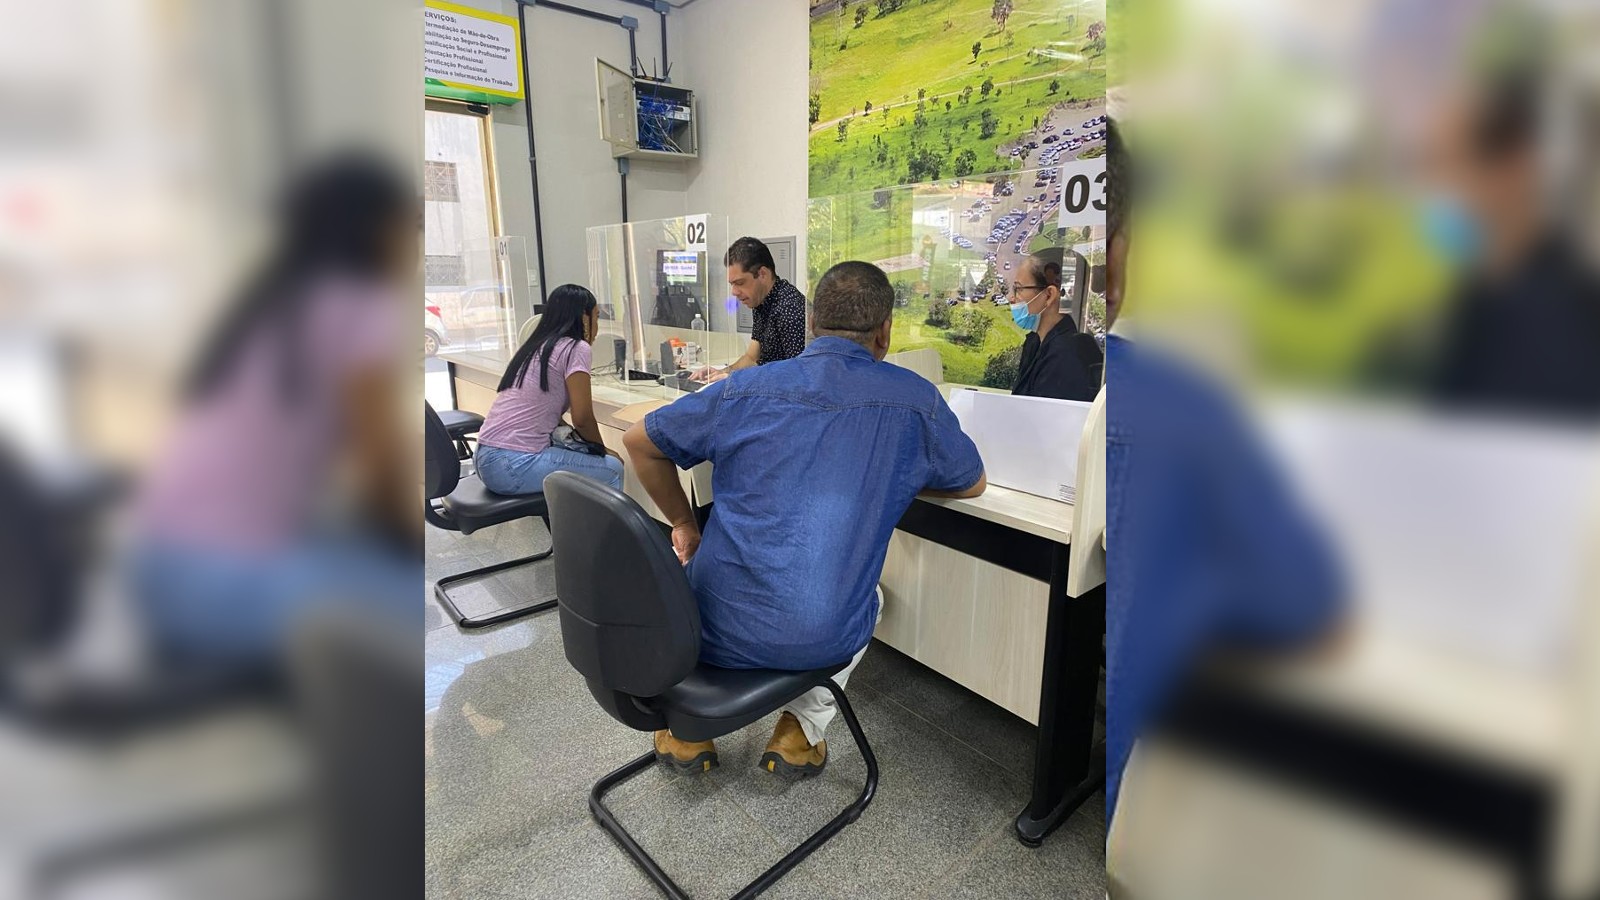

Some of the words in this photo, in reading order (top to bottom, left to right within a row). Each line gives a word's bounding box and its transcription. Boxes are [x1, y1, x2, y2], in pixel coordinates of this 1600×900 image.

[453, 54, 484, 64] Profissional
[456, 45, 472, 53] Social
[478, 50, 507, 60] Profissional
[457, 63, 488, 73] Profissional
[425, 66, 449, 76] Pesquisa
[454, 71, 484, 82] Informação
[491, 78, 513, 87] Trabalho
[1065, 171, 1106, 214] 03
[687, 222, 705, 244] 02
[499, 241, 508, 256] 01
